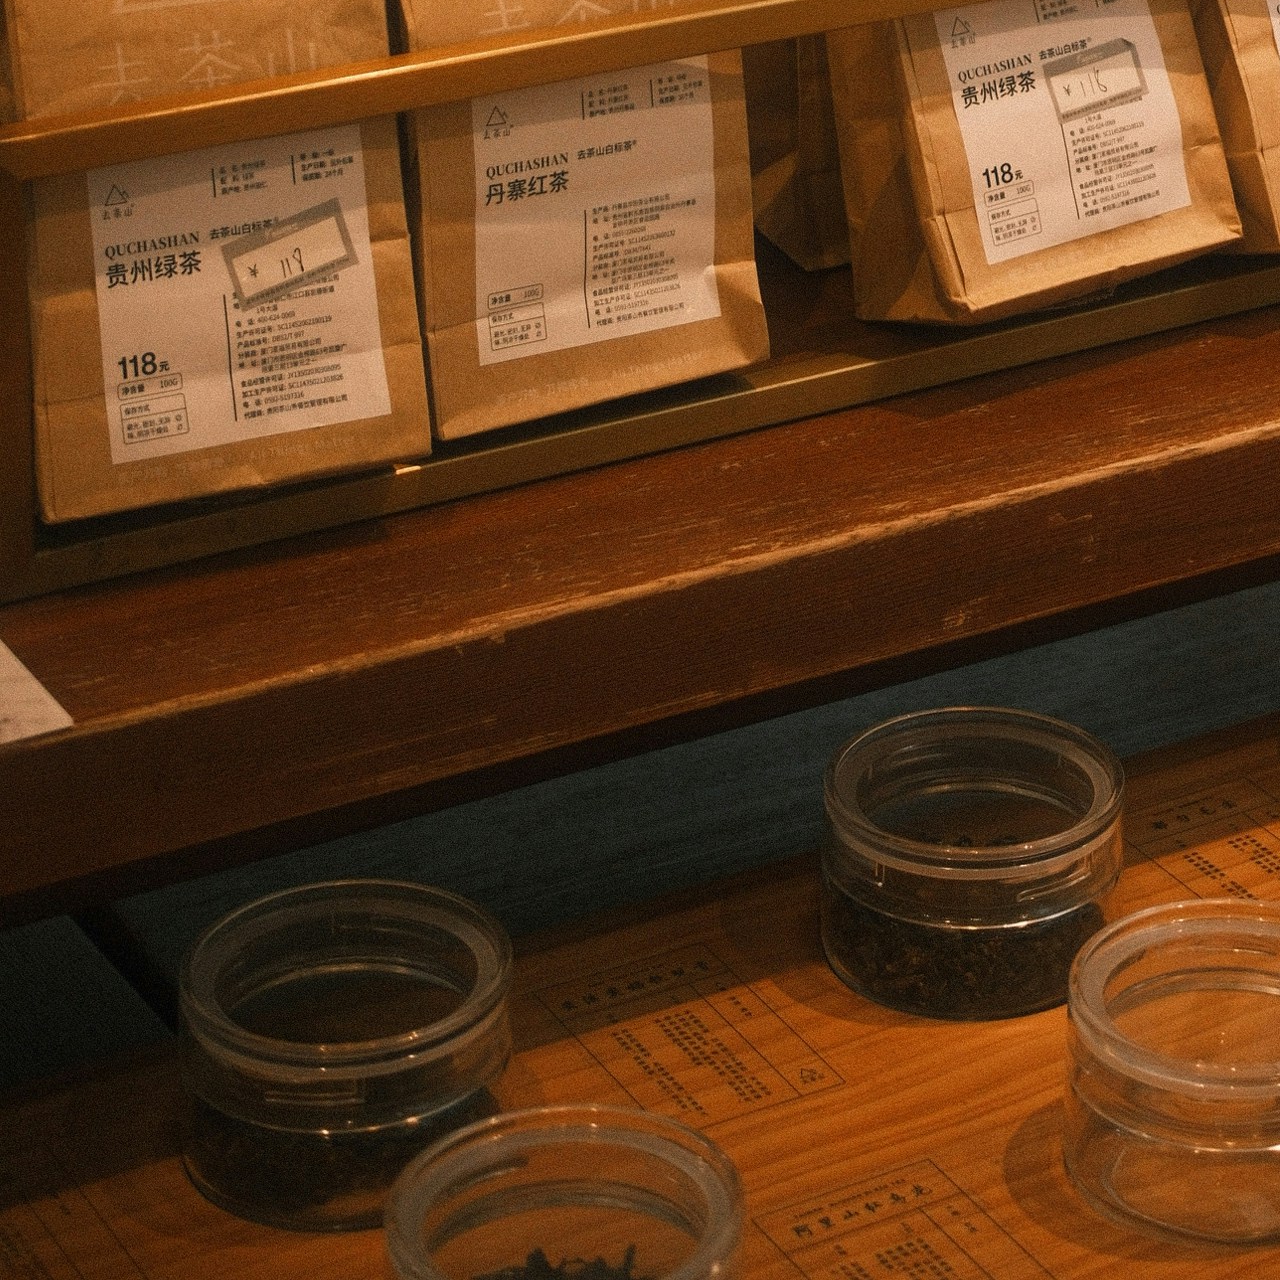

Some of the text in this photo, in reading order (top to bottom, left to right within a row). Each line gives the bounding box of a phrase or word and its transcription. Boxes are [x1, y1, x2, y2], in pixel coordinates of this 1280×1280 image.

[93, 28, 322, 104] 去茶山
[957, 38, 1089, 83] QUCHASHAN 去茶山白标茶
[960, 70, 1037, 110] 贵州绿茶
[1079, 65, 1109, 98] 118
[485, 139, 634, 179] QUCHASHAN 去茶山白标茶
[981, 161, 1024, 189] 118元
[485, 171, 570, 207] 丹寨红茶
[104, 217, 274, 259] QUCHASHAN 去茶山白标茶
[105, 249, 203, 290] 贵州绿茶
[117, 350, 171, 380] 118元
[121, 383, 145, 397] 净含量
